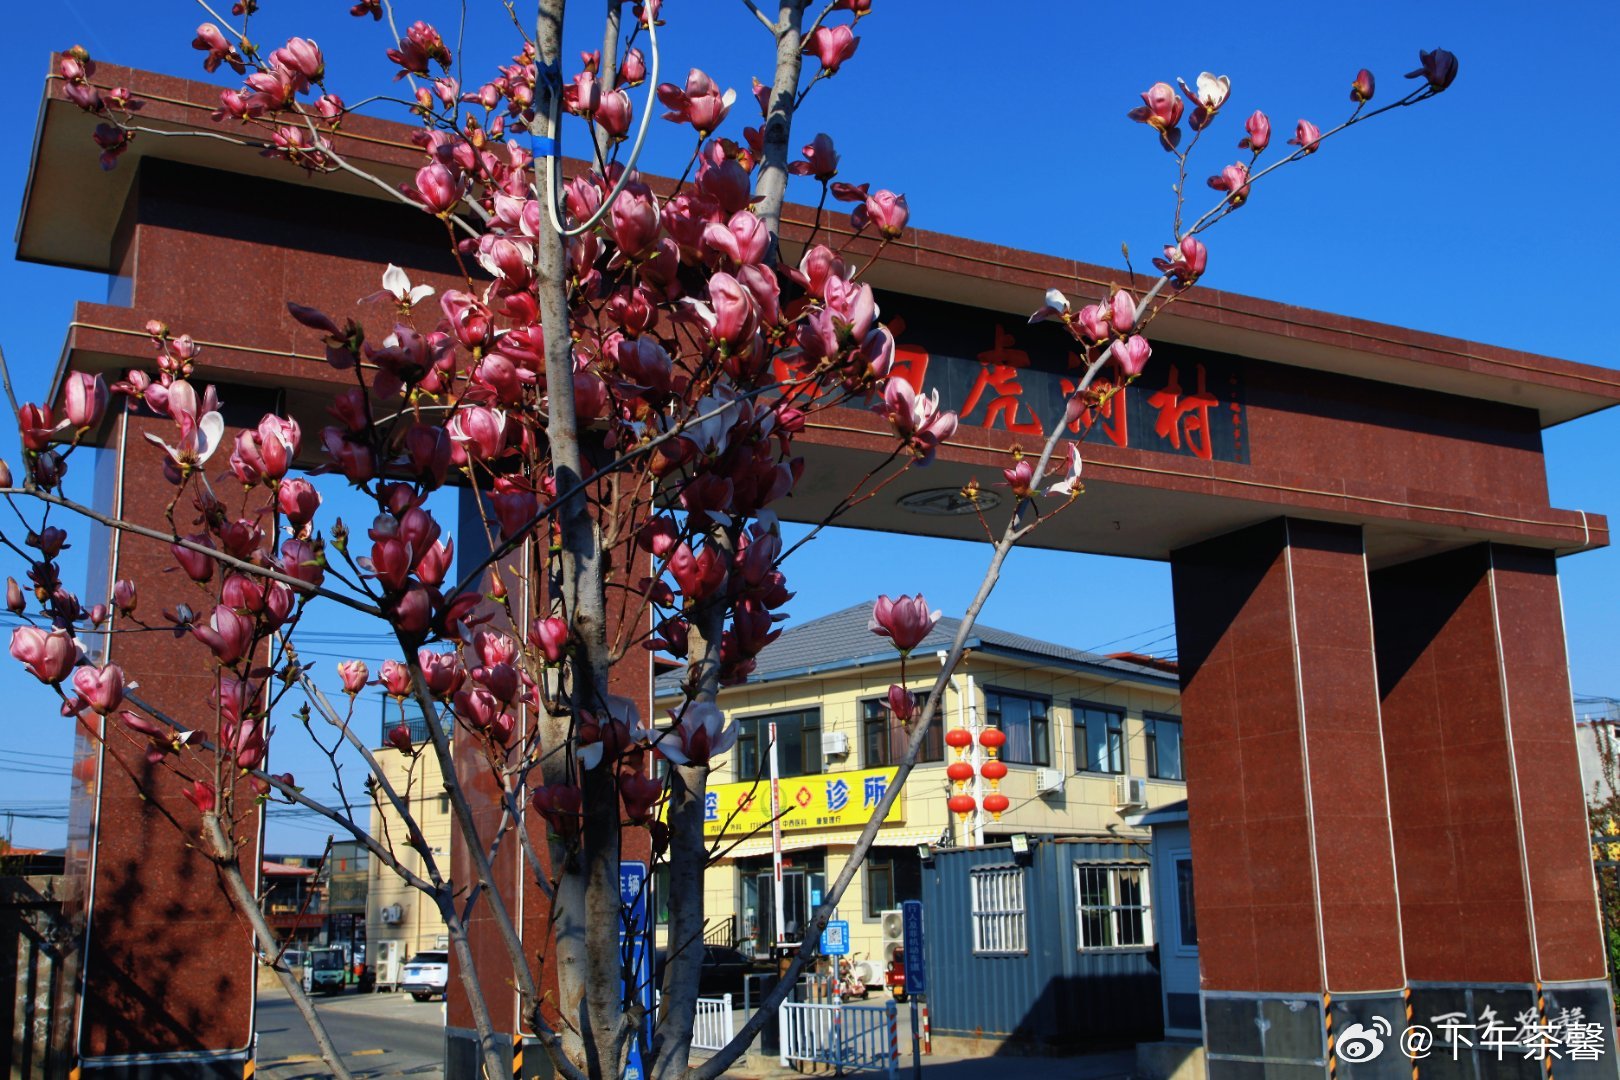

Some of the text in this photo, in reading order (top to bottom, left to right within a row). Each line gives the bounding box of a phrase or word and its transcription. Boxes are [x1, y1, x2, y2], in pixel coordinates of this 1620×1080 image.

[768, 297, 1219, 460] 白虎涧村
[826, 776, 887, 812] 诊所
[908, 904, 920, 971] 行人及非机动车道
